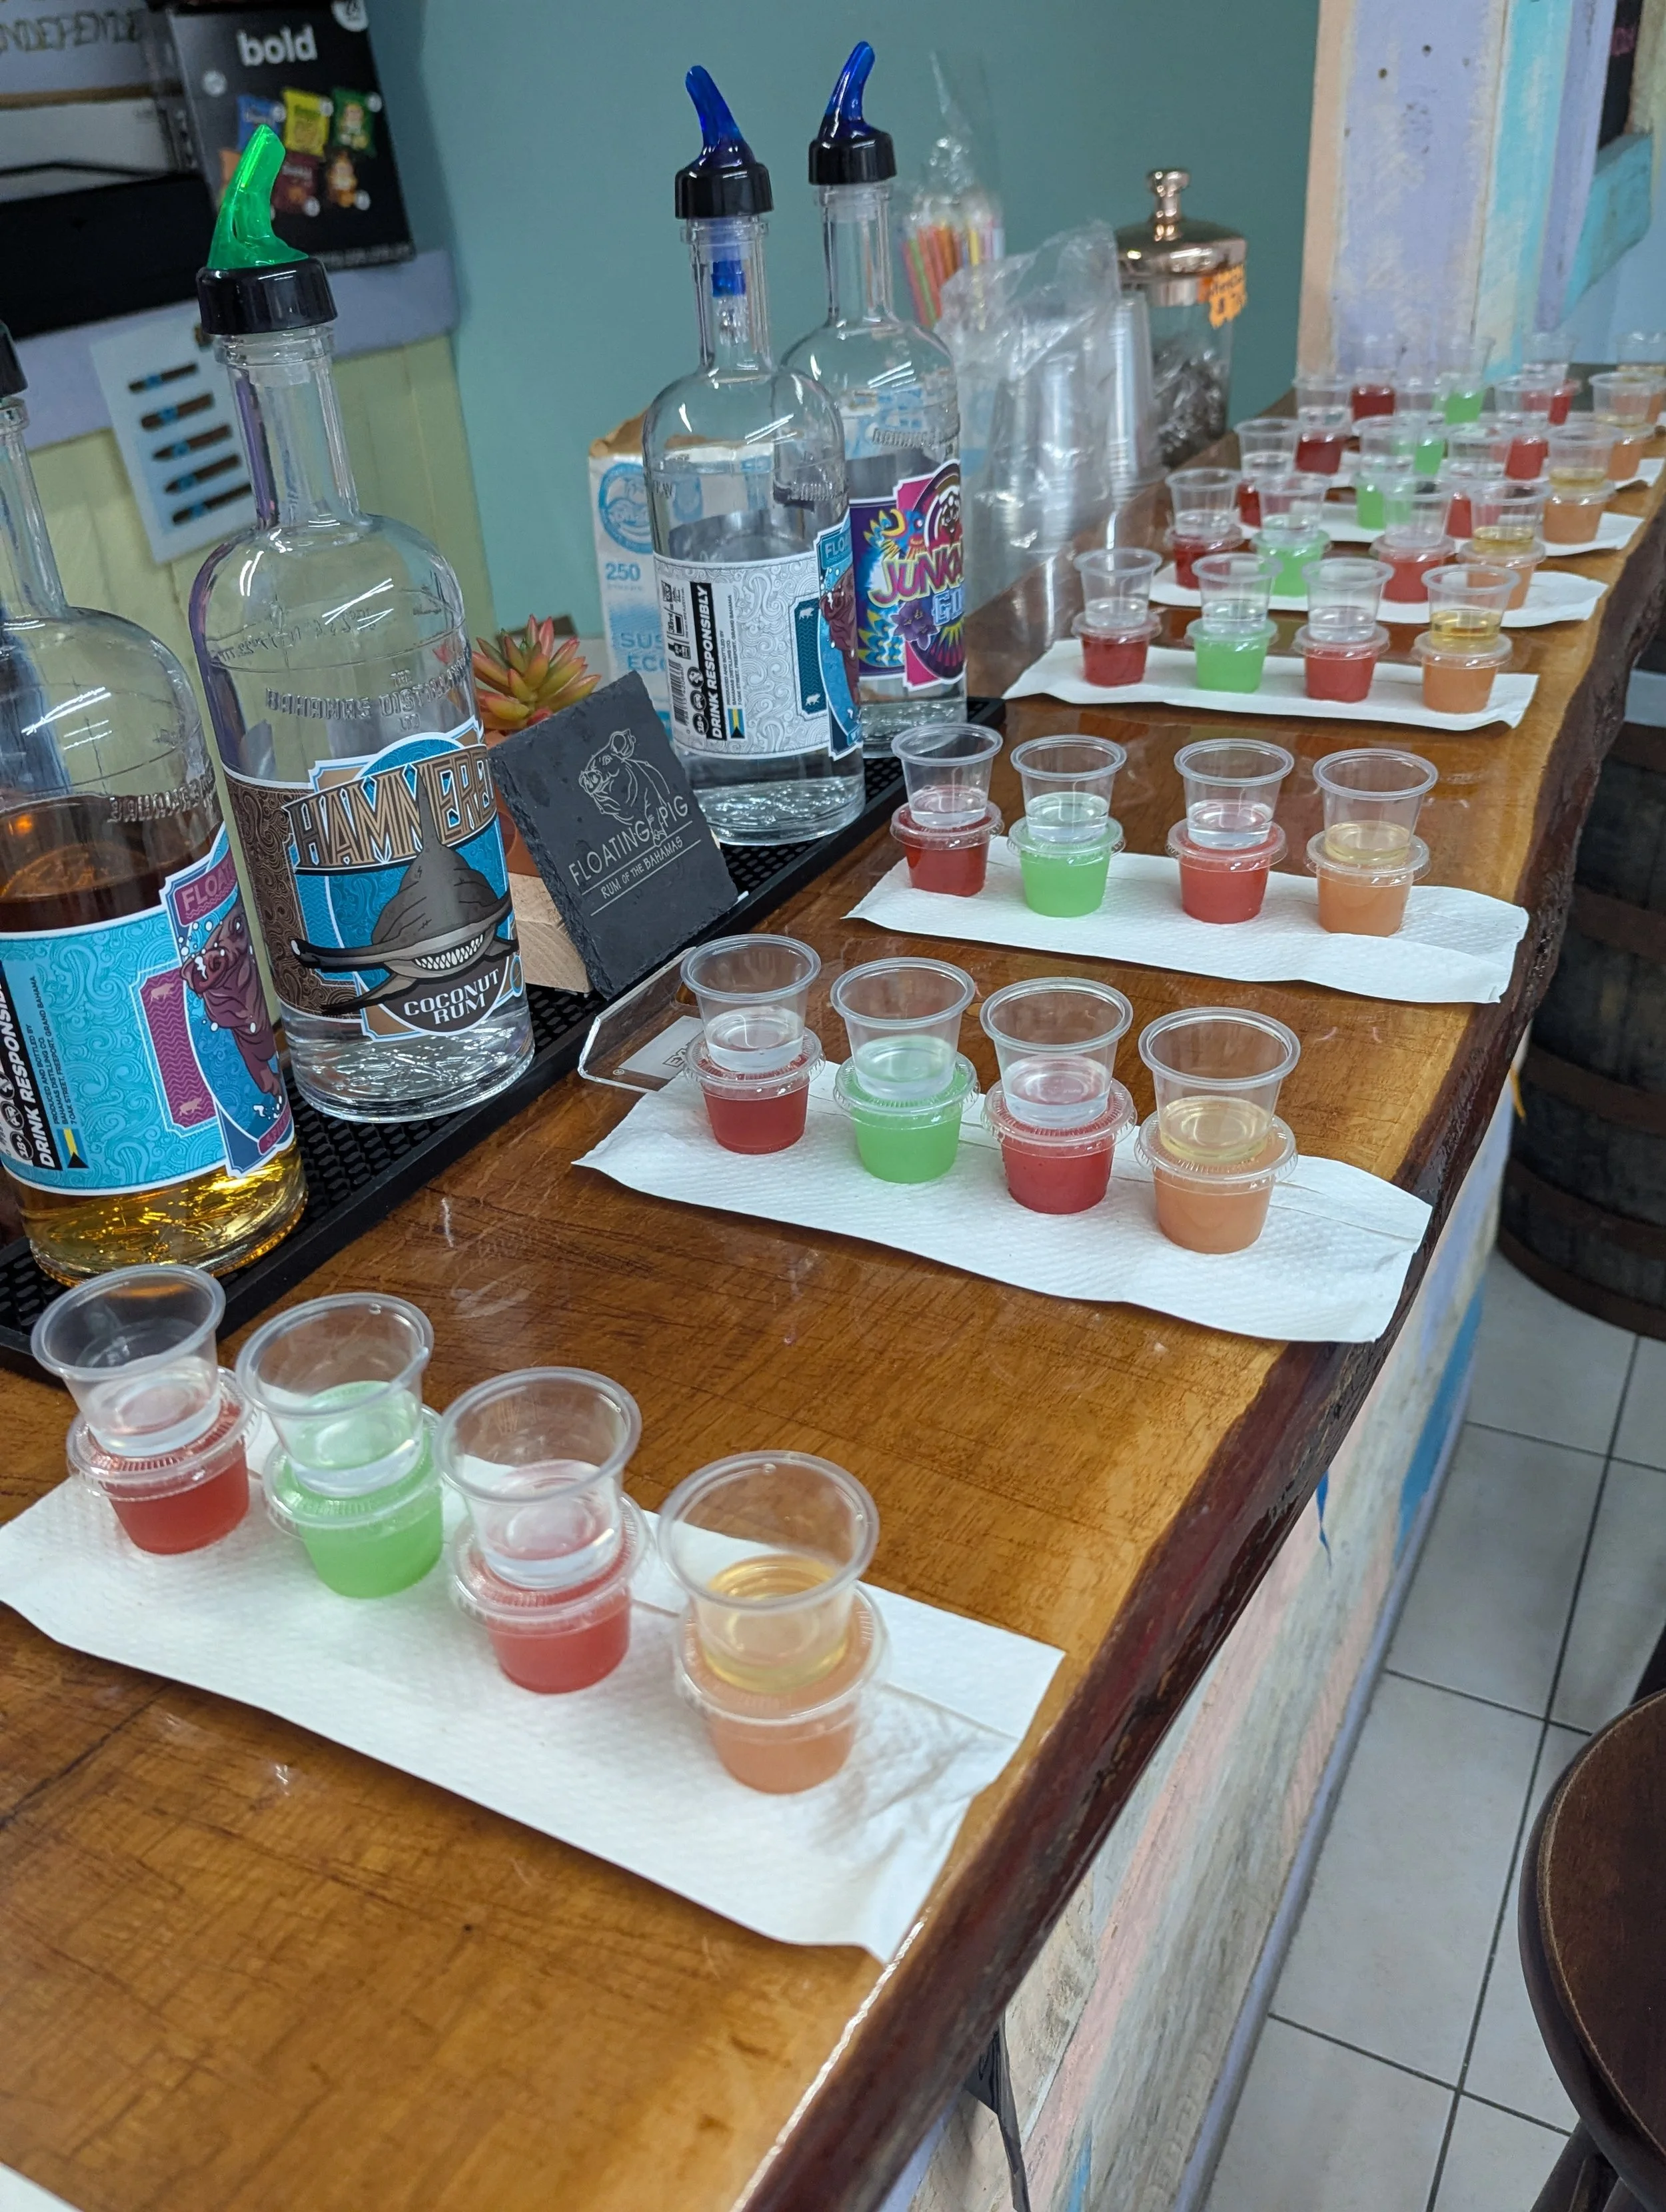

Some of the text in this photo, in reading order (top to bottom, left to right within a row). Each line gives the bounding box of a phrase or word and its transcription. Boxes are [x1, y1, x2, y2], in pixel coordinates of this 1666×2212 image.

[237, 23, 317, 66] bold
[605, 562, 641, 581] 250
[697, 585, 723, 739] DRINK RESPONSIBLY
[568, 796, 688, 886] FLOATING PIG
[600, 835, 683, 899] RUM OF THE BAHAMAS
[29, 975, 44, 1008] BAHAMA
[404, 968, 500, 1017] COCONUT
[39, 1010, 51, 1036] GRAND
[434, 997, 486, 1025] RUM
[26, 1023, 60, 1125] PRODUCED AND BOTTLED BY
[42, 1050, 58, 1088] DISTILLING
[47, 1037, 63, 1075] FREEPORT,
[53, 1090, 68, 1125] BAHAMAS
[59, 1076, 71, 1103] STREET,
[67, 1105, 75, 1119] OAK
[16, 1135, 29, 1158] 18+
[24, 1105, 55, 1167] DRINK
